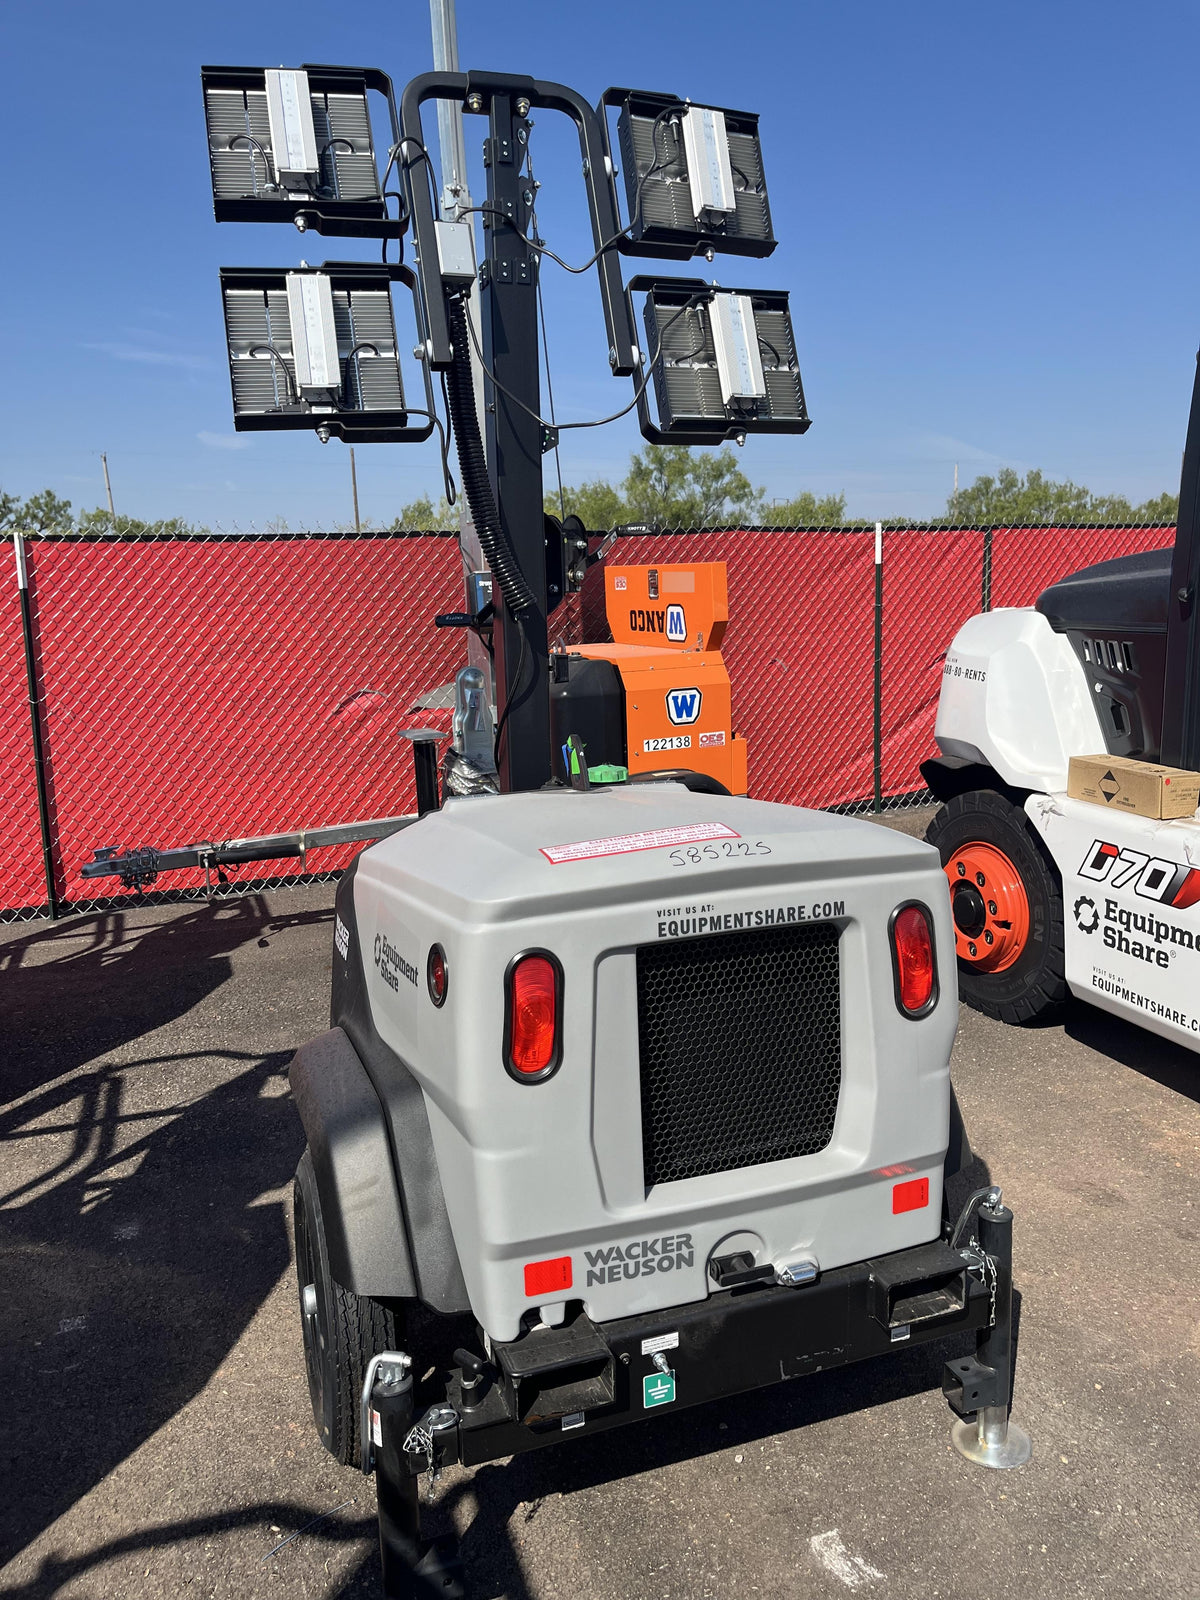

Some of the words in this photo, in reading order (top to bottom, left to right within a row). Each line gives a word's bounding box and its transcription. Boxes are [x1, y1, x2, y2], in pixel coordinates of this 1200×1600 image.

[672, 693, 697, 719] W
[645, 736, 691, 751] 122138
[669, 841, 772, 867] 585225
[1077, 839, 1178, 902] D70
[656, 908, 681, 918] VISIT
[685, 906, 697, 914] US
[701, 904, 715, 913] AT:
[657, 900, 846, 938] EQUIPMENTSHARE.COM
[380, 958, 399, 993] Share
[381, 934, 419, 987] Equipment
[1092, 966, 1107, 976] VISIT
[1091, 974, 1200, 1033] EQUIPMENTSHARE.C
[584, 1233, 695, 1268] WACKER
[586, 1250, 695, 1287] NEUSON
